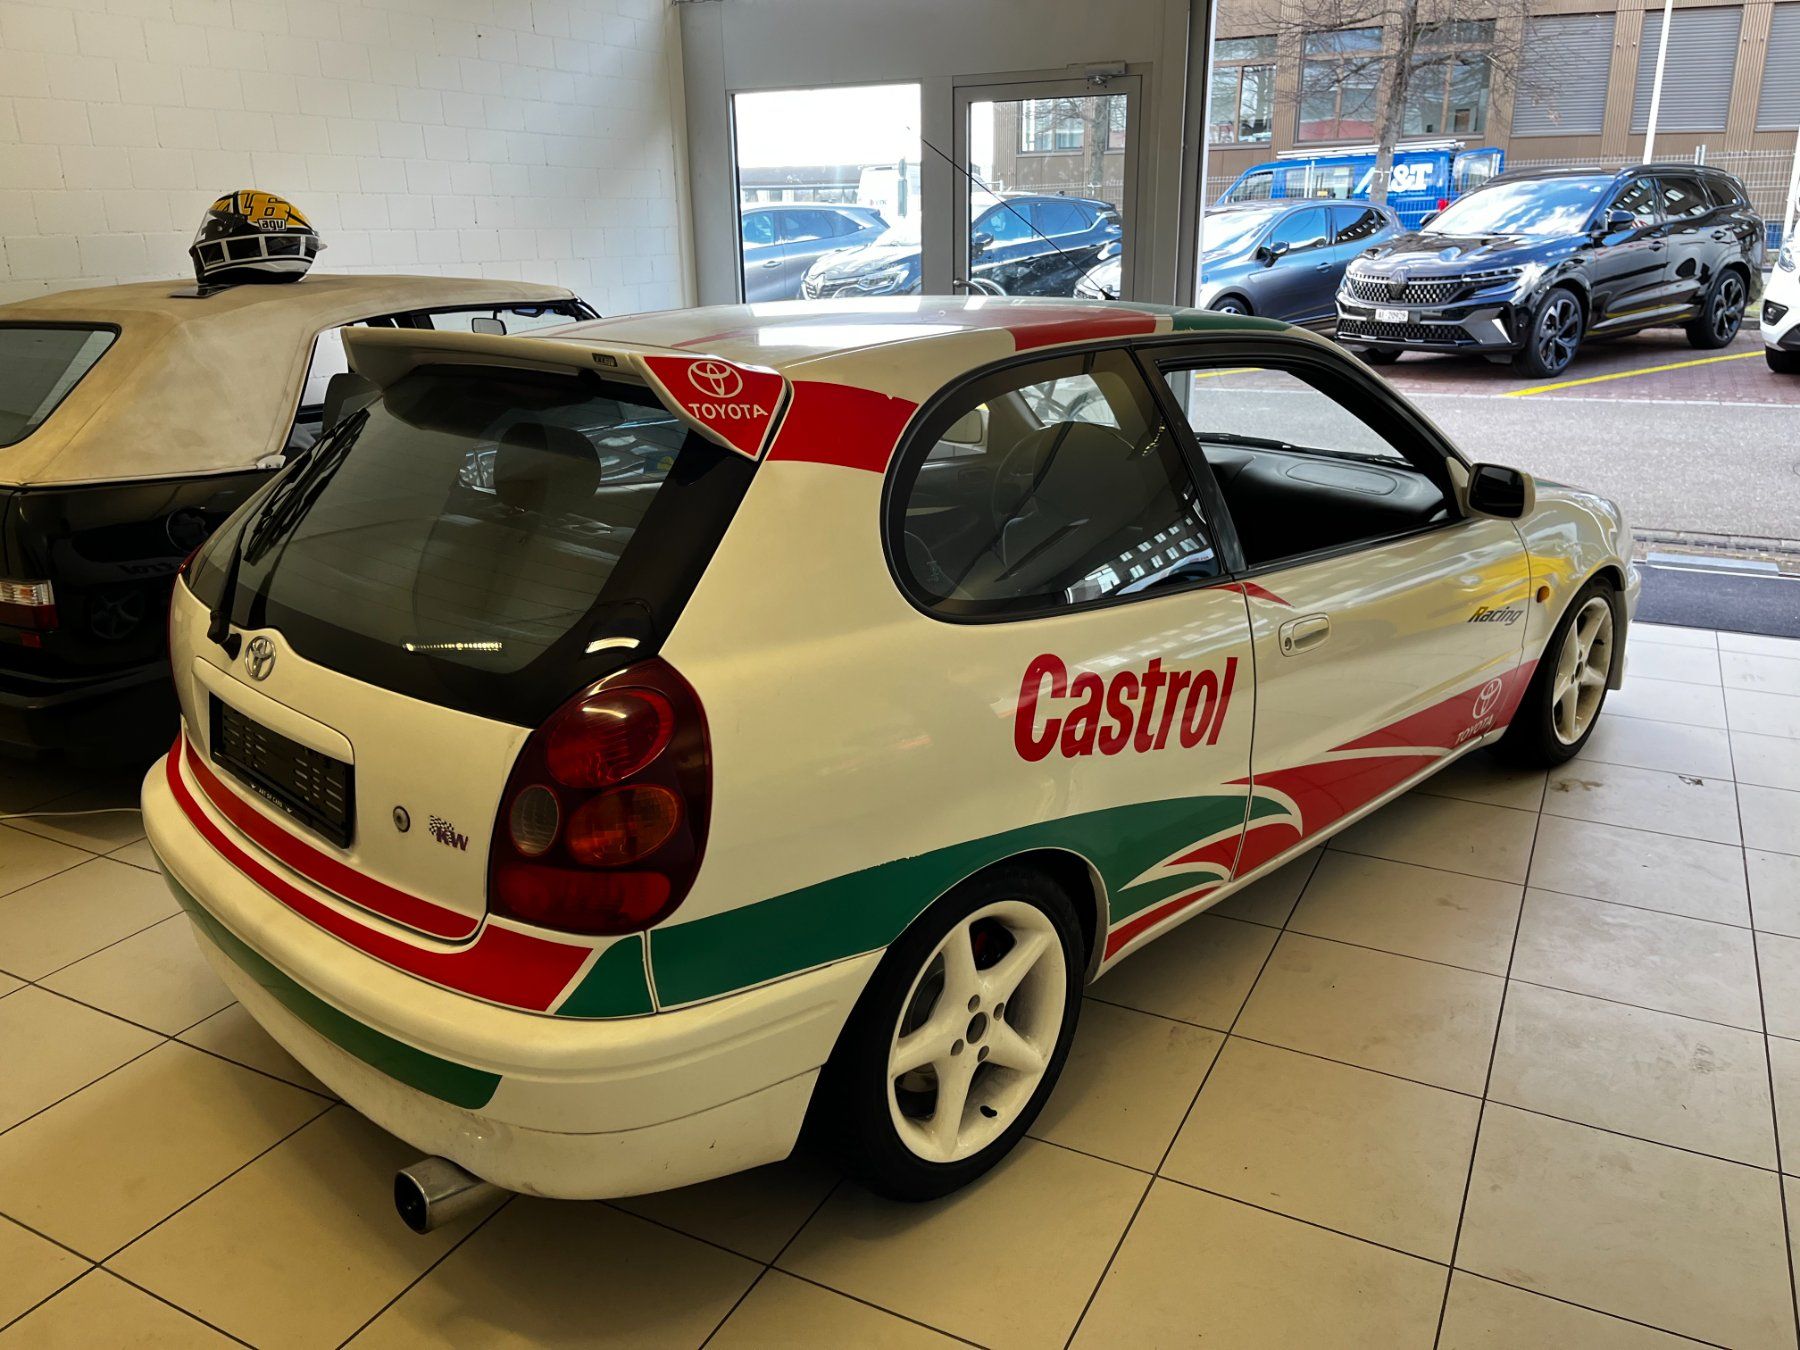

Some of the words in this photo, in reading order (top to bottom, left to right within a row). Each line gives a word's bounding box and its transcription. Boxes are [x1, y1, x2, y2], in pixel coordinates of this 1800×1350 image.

[261, 219, 284, 231] agv
[688, 403, 769, 420] TOYOTA
[1467, 606, 1524, 626] Racing
[1014, 653, 1238, 762] Castrol
[1455, 714, 1494, 745] TOYOTA
